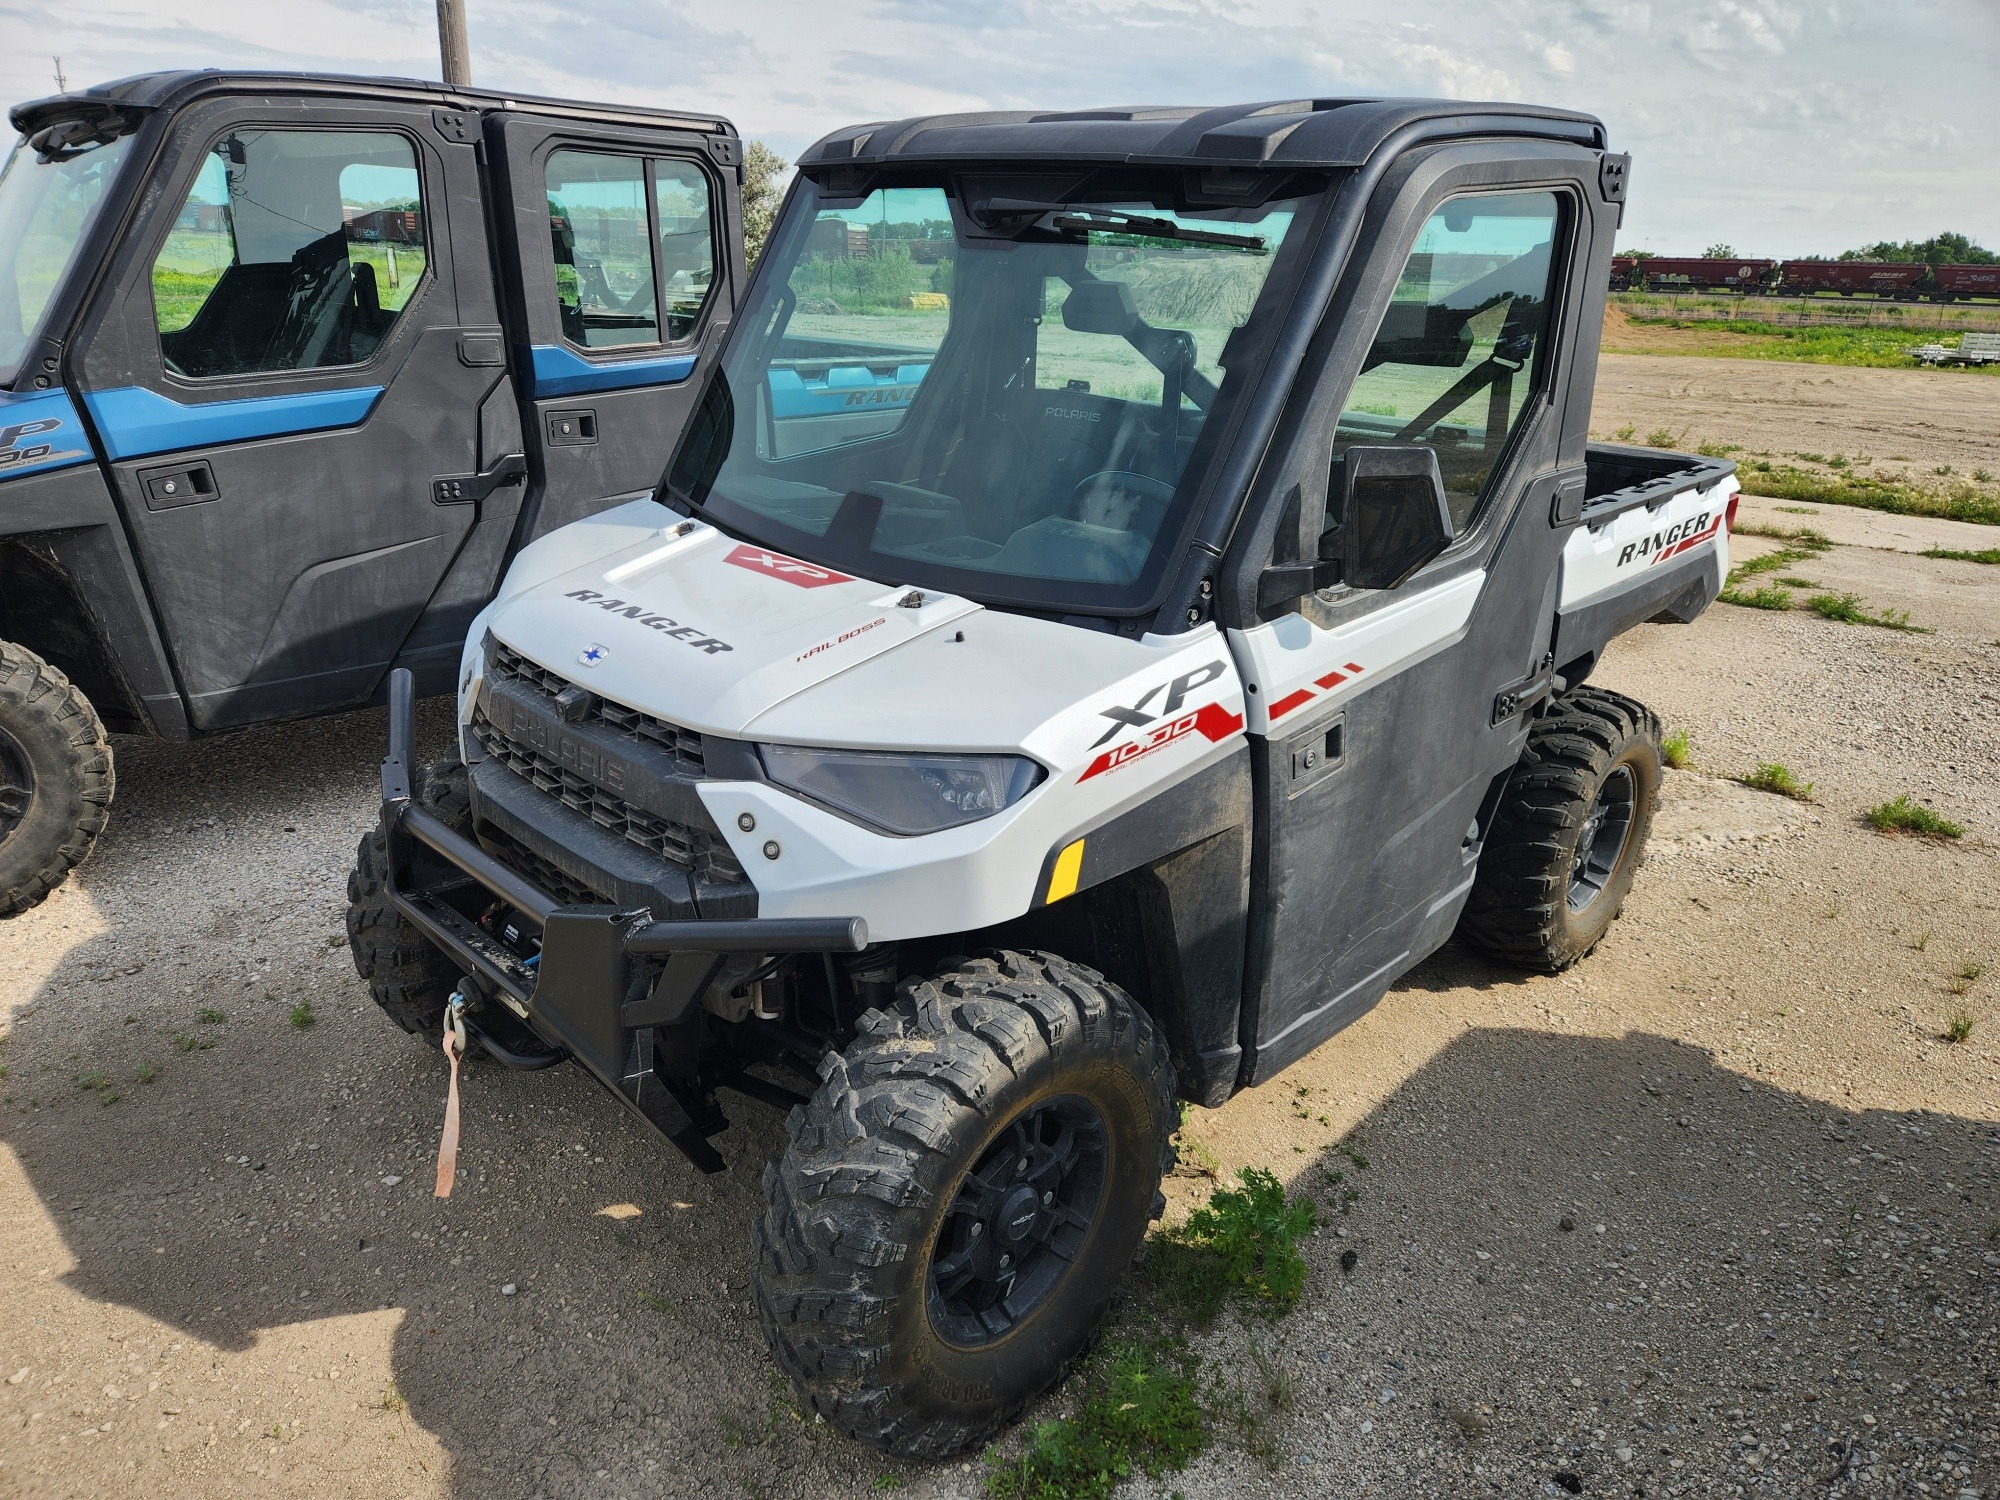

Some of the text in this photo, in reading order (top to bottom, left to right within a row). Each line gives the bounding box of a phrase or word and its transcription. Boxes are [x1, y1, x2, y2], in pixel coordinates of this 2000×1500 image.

[1045, 407, 1101, 423] POLARIS
[0, 418, 63, 449] P
[1616, 511, 1710, 568] RANGER
[737, 553, 831, 579] XP
[563, 589, 734, 655] RANGER
[838, 617, 886, 644] BOSS
[1085, 659, 1228, 752] XP
[1105, 763, 1128, 777] DUAL
